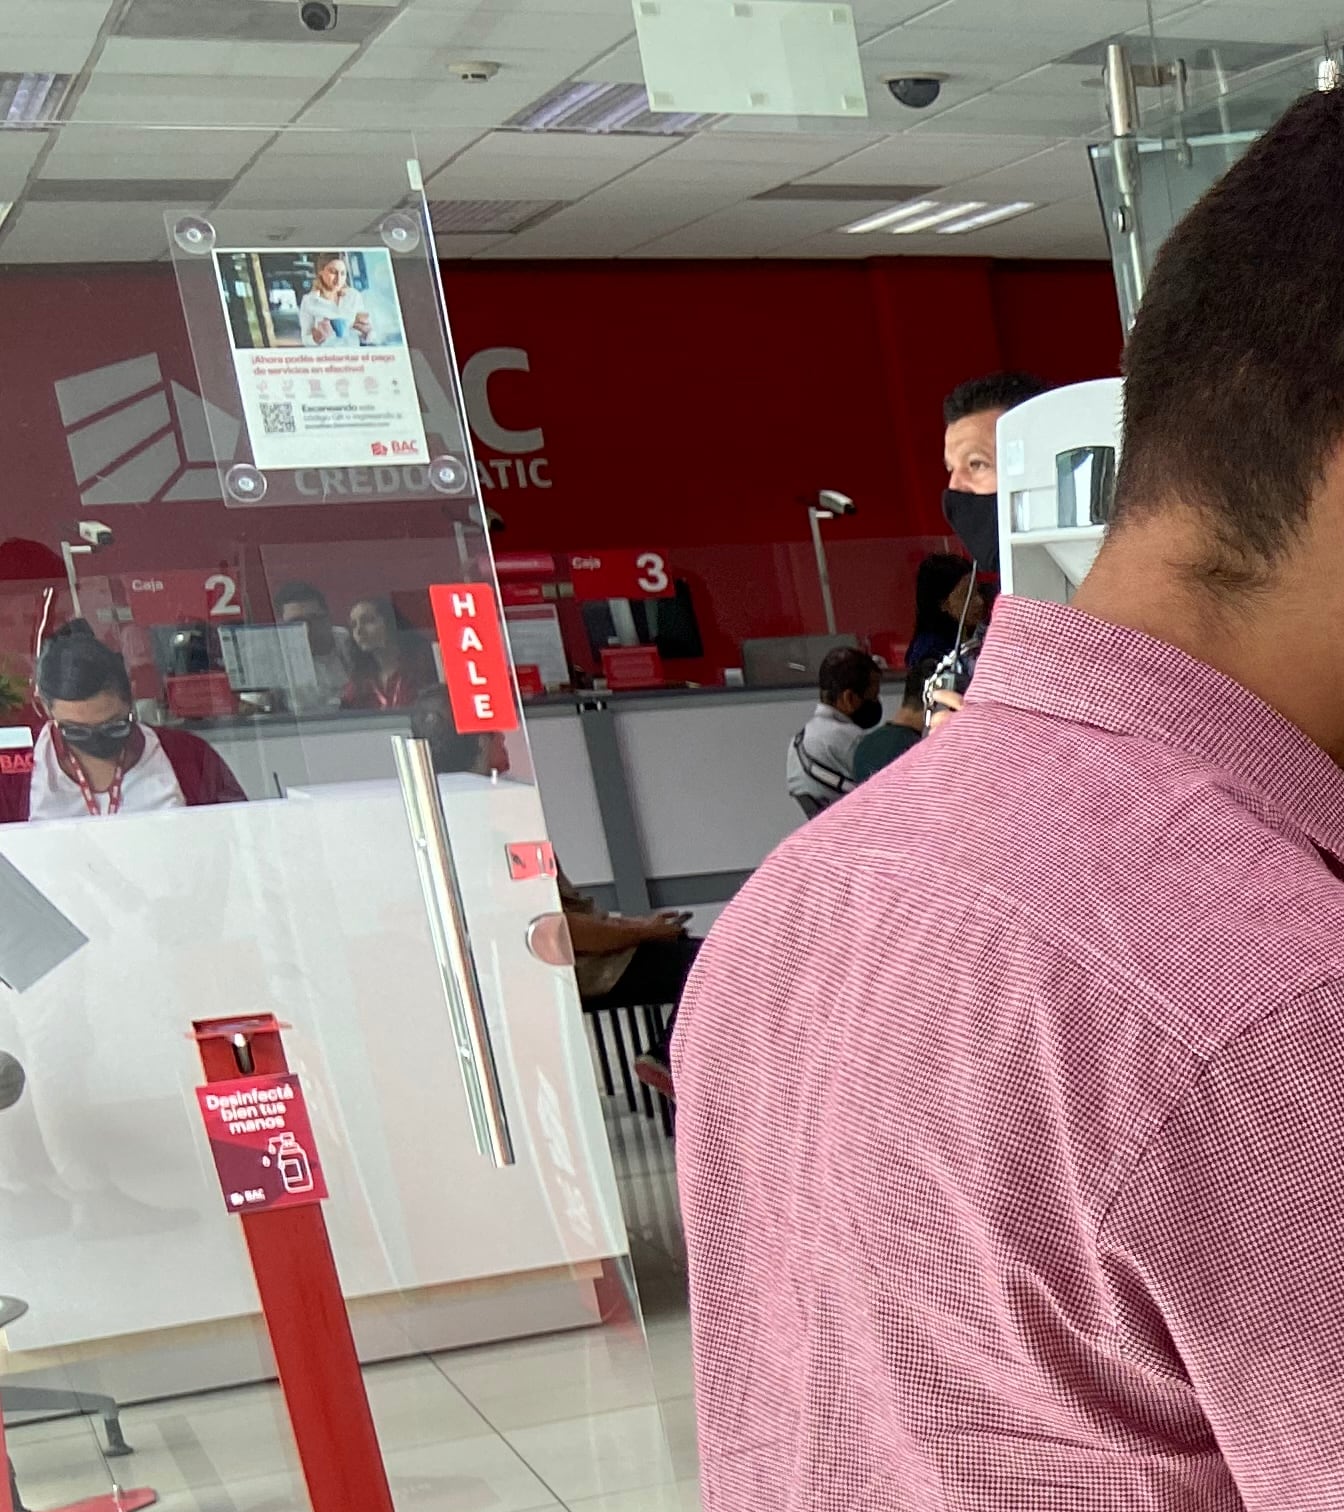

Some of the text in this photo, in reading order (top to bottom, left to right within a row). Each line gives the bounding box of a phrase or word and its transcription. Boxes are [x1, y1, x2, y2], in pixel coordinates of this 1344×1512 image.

[371, 353, 395, 363] pago
[253, 367, 266, 375] de
[391, 440, 419, 451] BAC
[294, 458, 553, 496] CREDOATIC
[636, 552, 668, 592] 3
[205, 574, 241, 616] 2
[452, 593, 494, 719] HALE
[205, 1083, 294, 1111] Desinfectá
[221, 1101, 287, 1123] bien tus
[229, 1115, 285, 1135] manos
